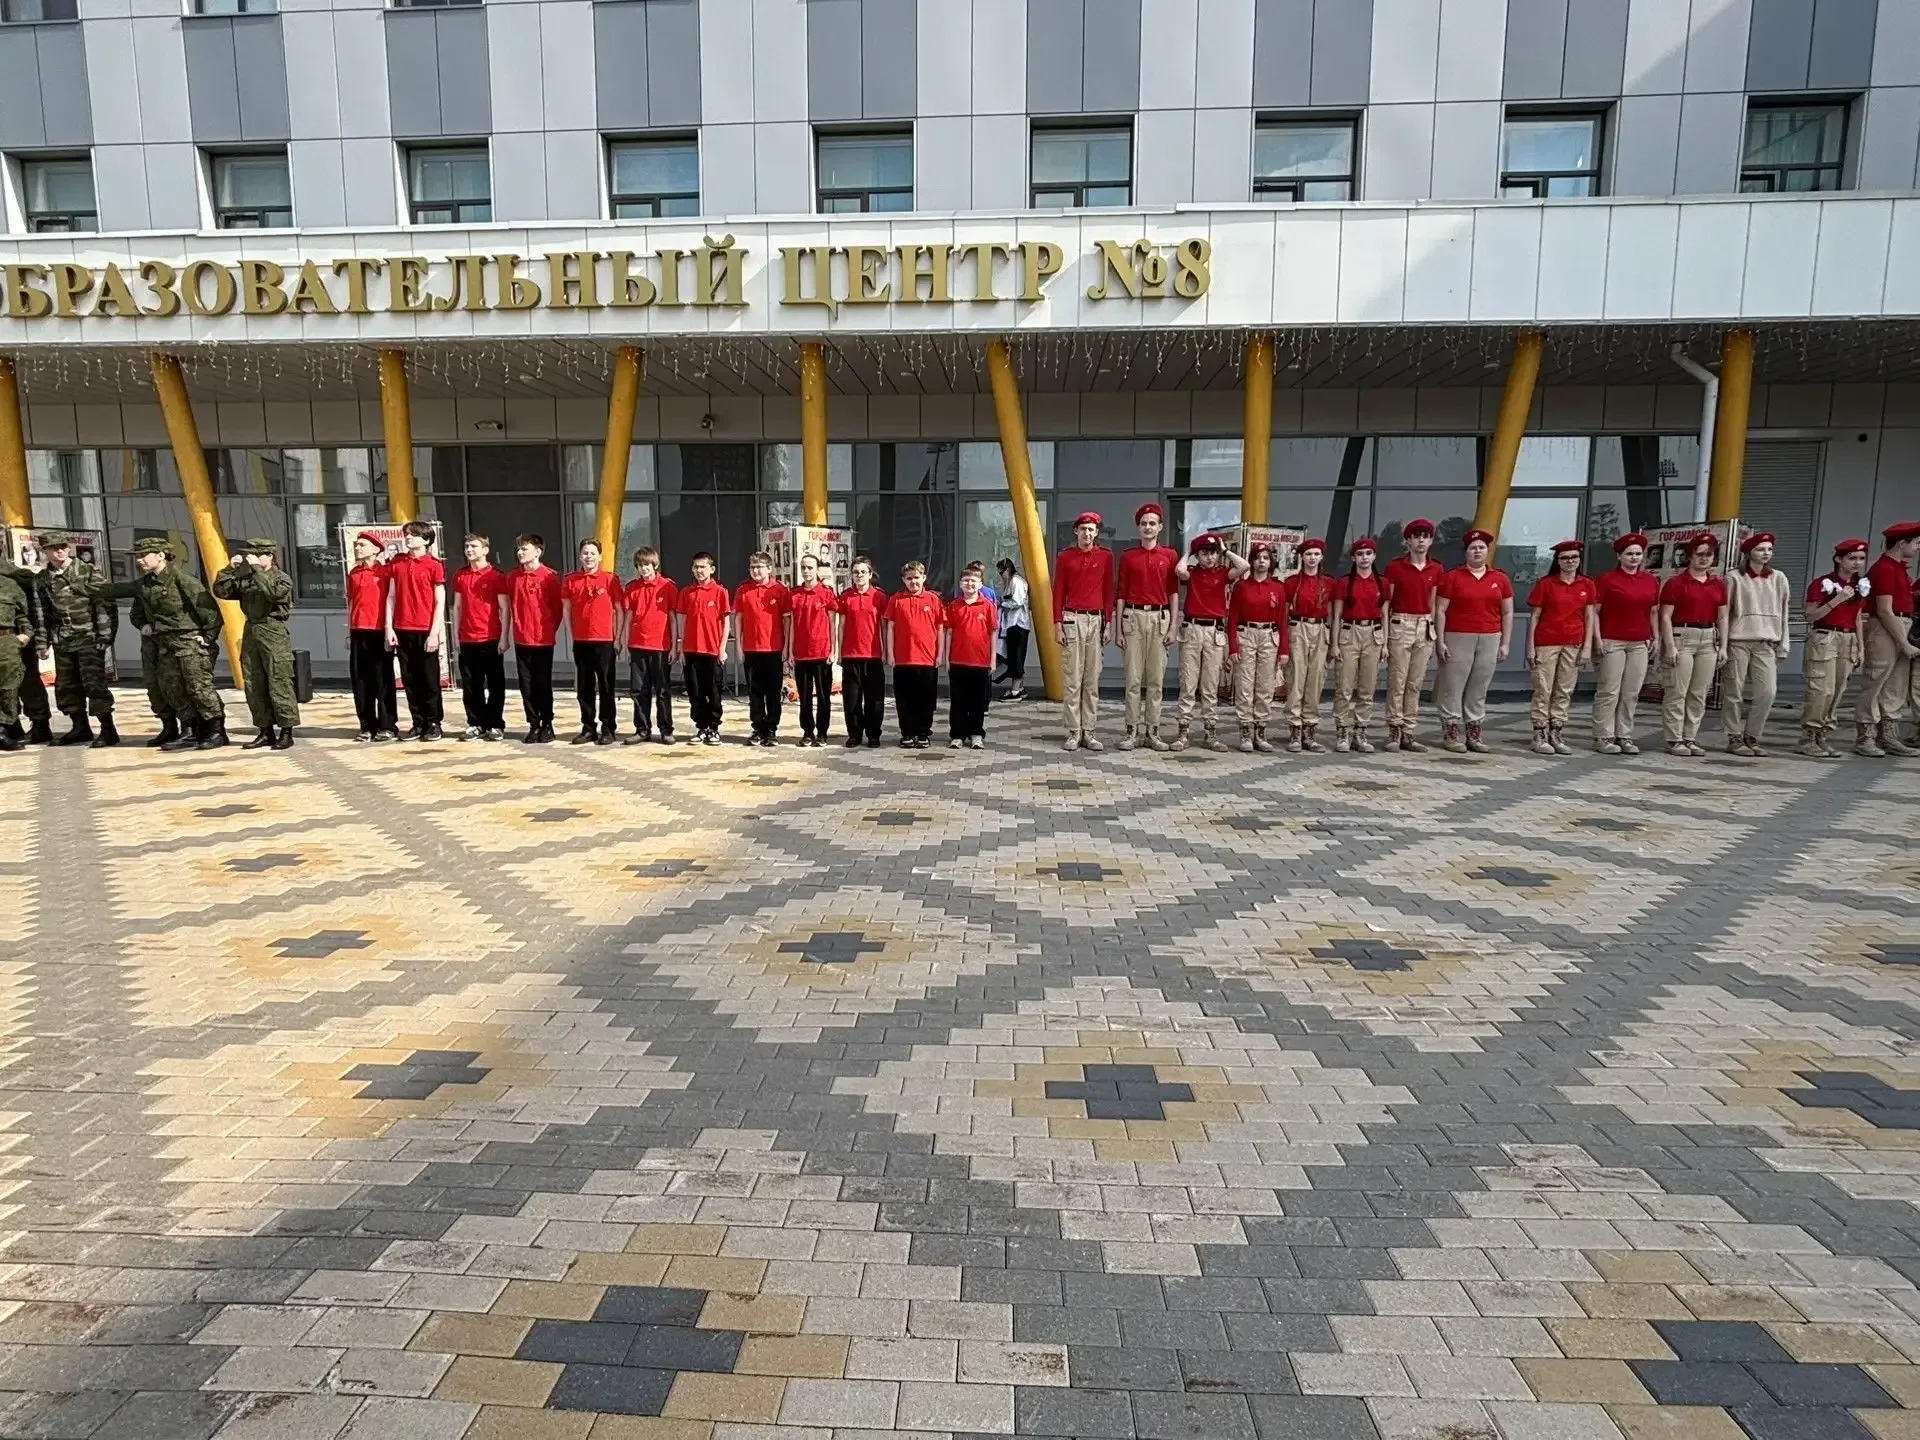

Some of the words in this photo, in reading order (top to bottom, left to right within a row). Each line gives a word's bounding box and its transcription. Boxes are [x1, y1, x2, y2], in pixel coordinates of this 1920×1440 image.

[0, 234, 747, 318] БРАЗОВАТЕЛЬНЫЙ
[778, 240, 1063, 320] ЦЕНТР
[1087, 238, 1212, 300] №8
[367, 529, 403, 540] ПОМНИ
